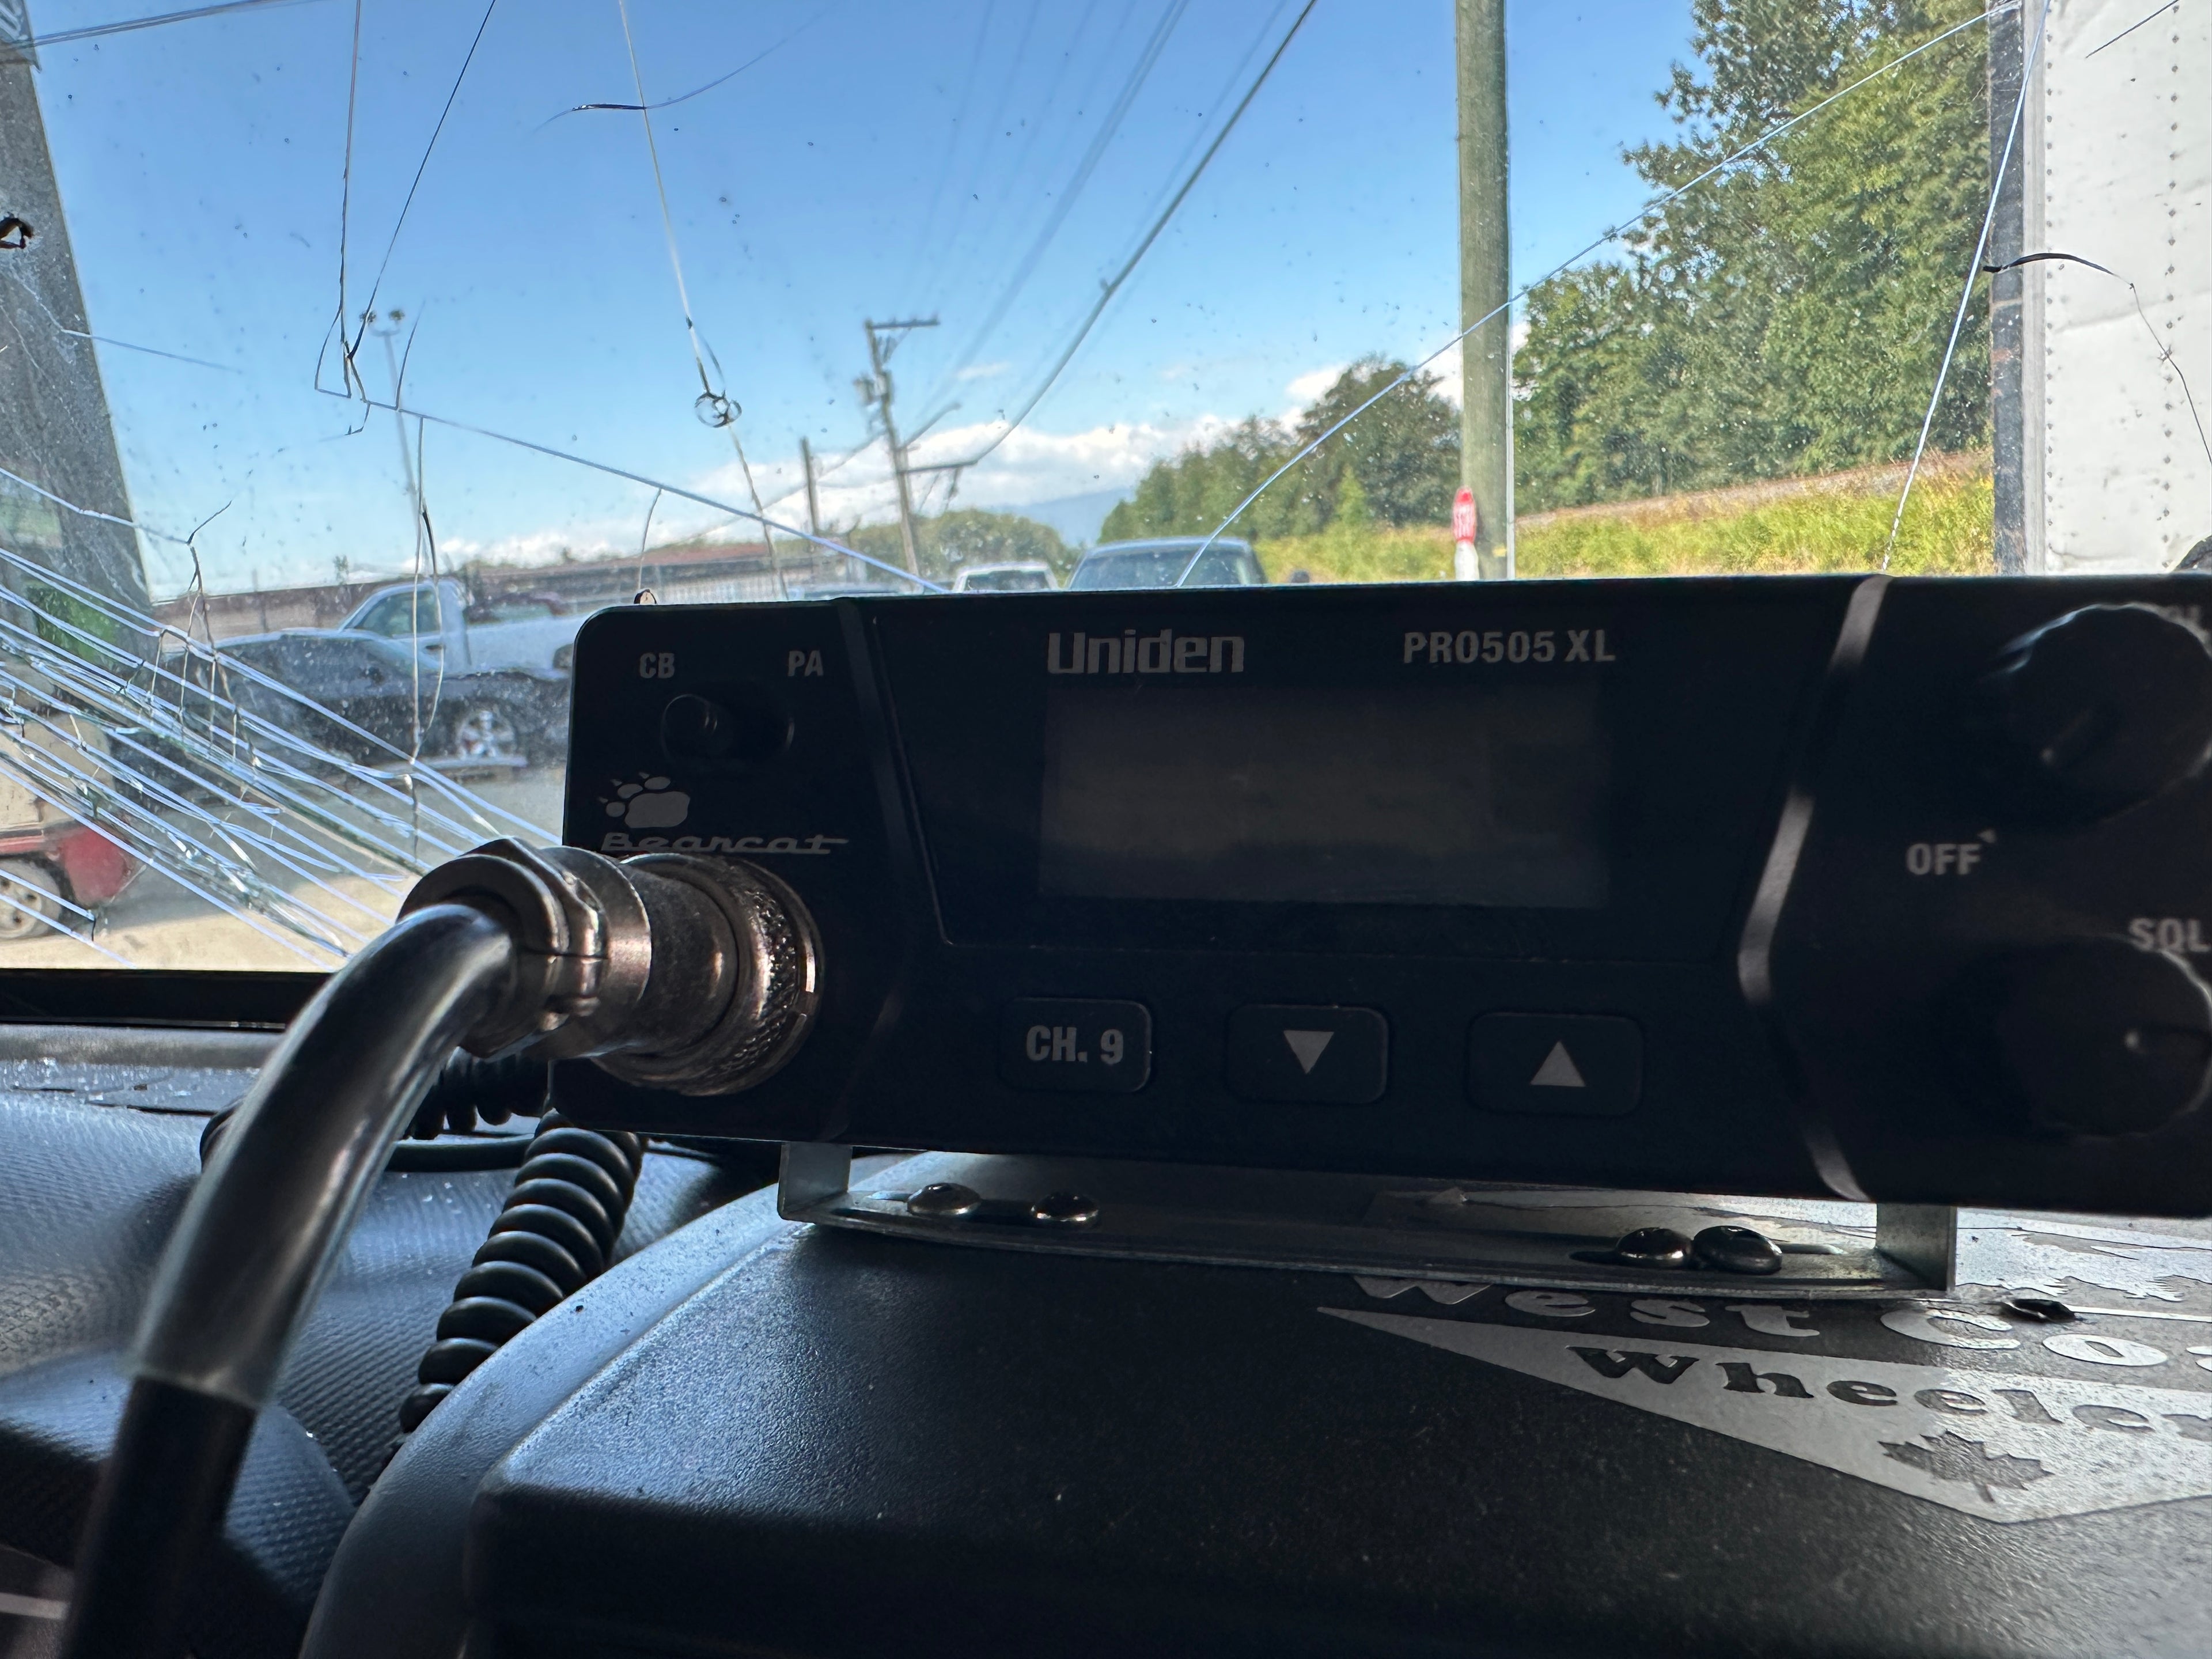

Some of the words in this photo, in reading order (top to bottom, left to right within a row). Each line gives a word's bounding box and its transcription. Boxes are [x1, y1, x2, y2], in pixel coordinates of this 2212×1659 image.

[1047, 628, 1245, 674] Uniden
[1564, 628, 1616, 662] XL
[639, 652, 675, 679] CB
[787, 650, 824, 677] PA
[601, 832, 850, 855] Bearcat
[1906, 843, 1982, 875] OFF
[1026, 1025, 1088, 1063] CH.
[1100, 1029, 1124, 1065] 9
[1880, 1308, 2212, 1373] Co
